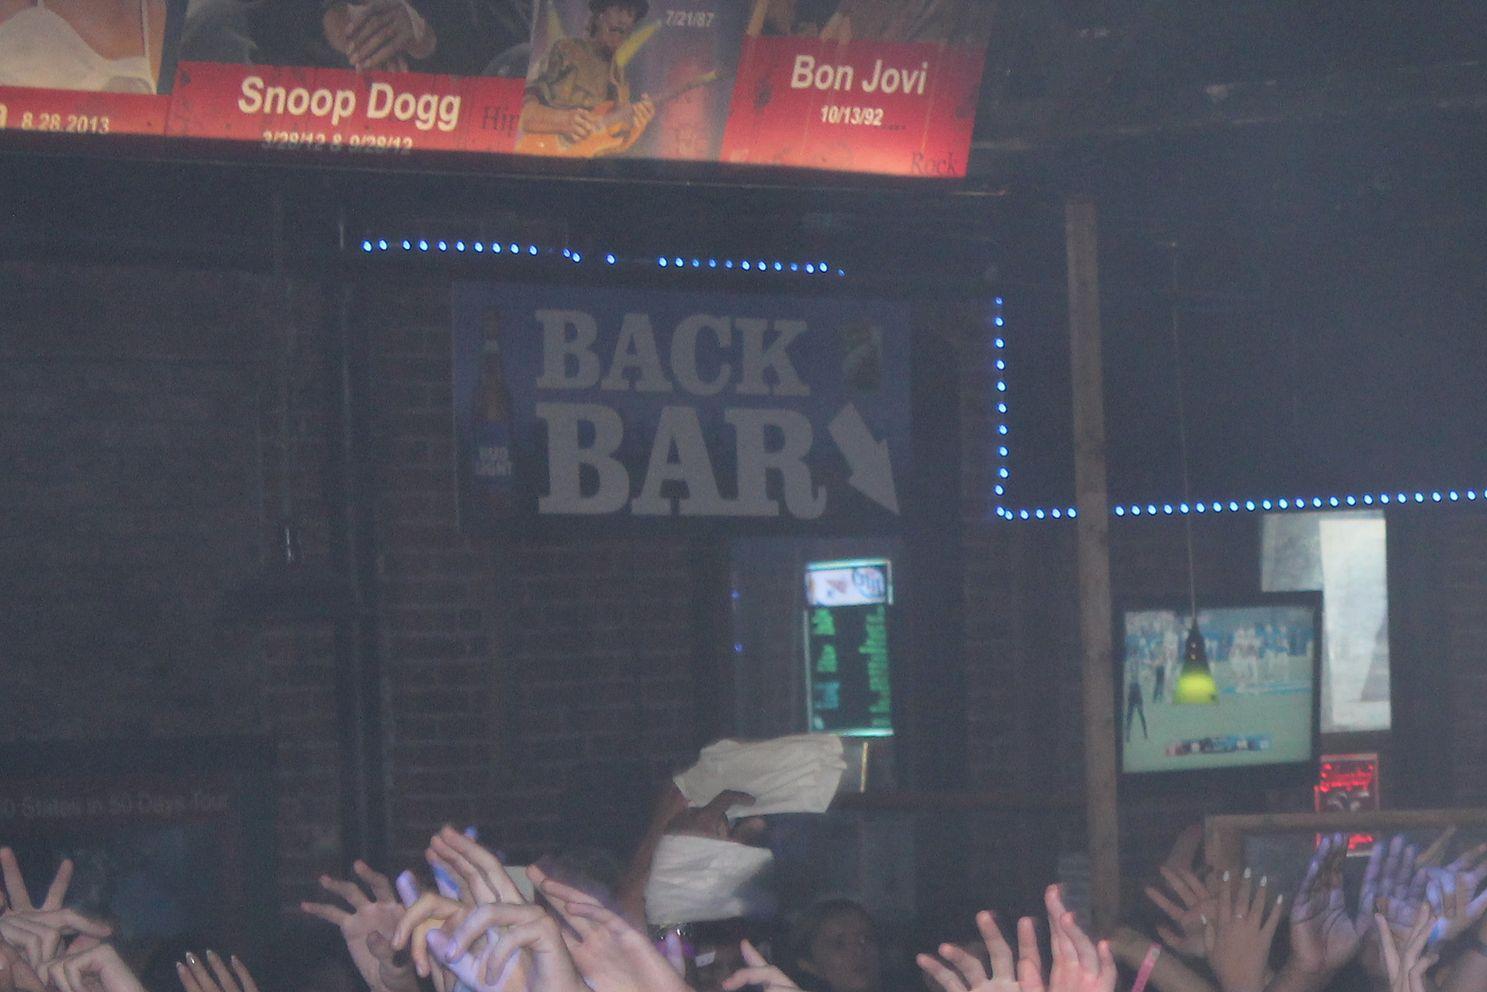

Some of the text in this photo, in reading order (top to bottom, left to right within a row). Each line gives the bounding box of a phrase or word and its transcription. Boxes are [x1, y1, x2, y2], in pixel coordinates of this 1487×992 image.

[791, 55, 929, 94] Bon Jovi
[238, 76, 461, 132] Snoop Dogg
[821, 105, 884, 126] 10/13/92
[911, 152, 957, 175] Rock
[535, 309, 809, 397] BACK
[537, 402, 828, 520] BAR
